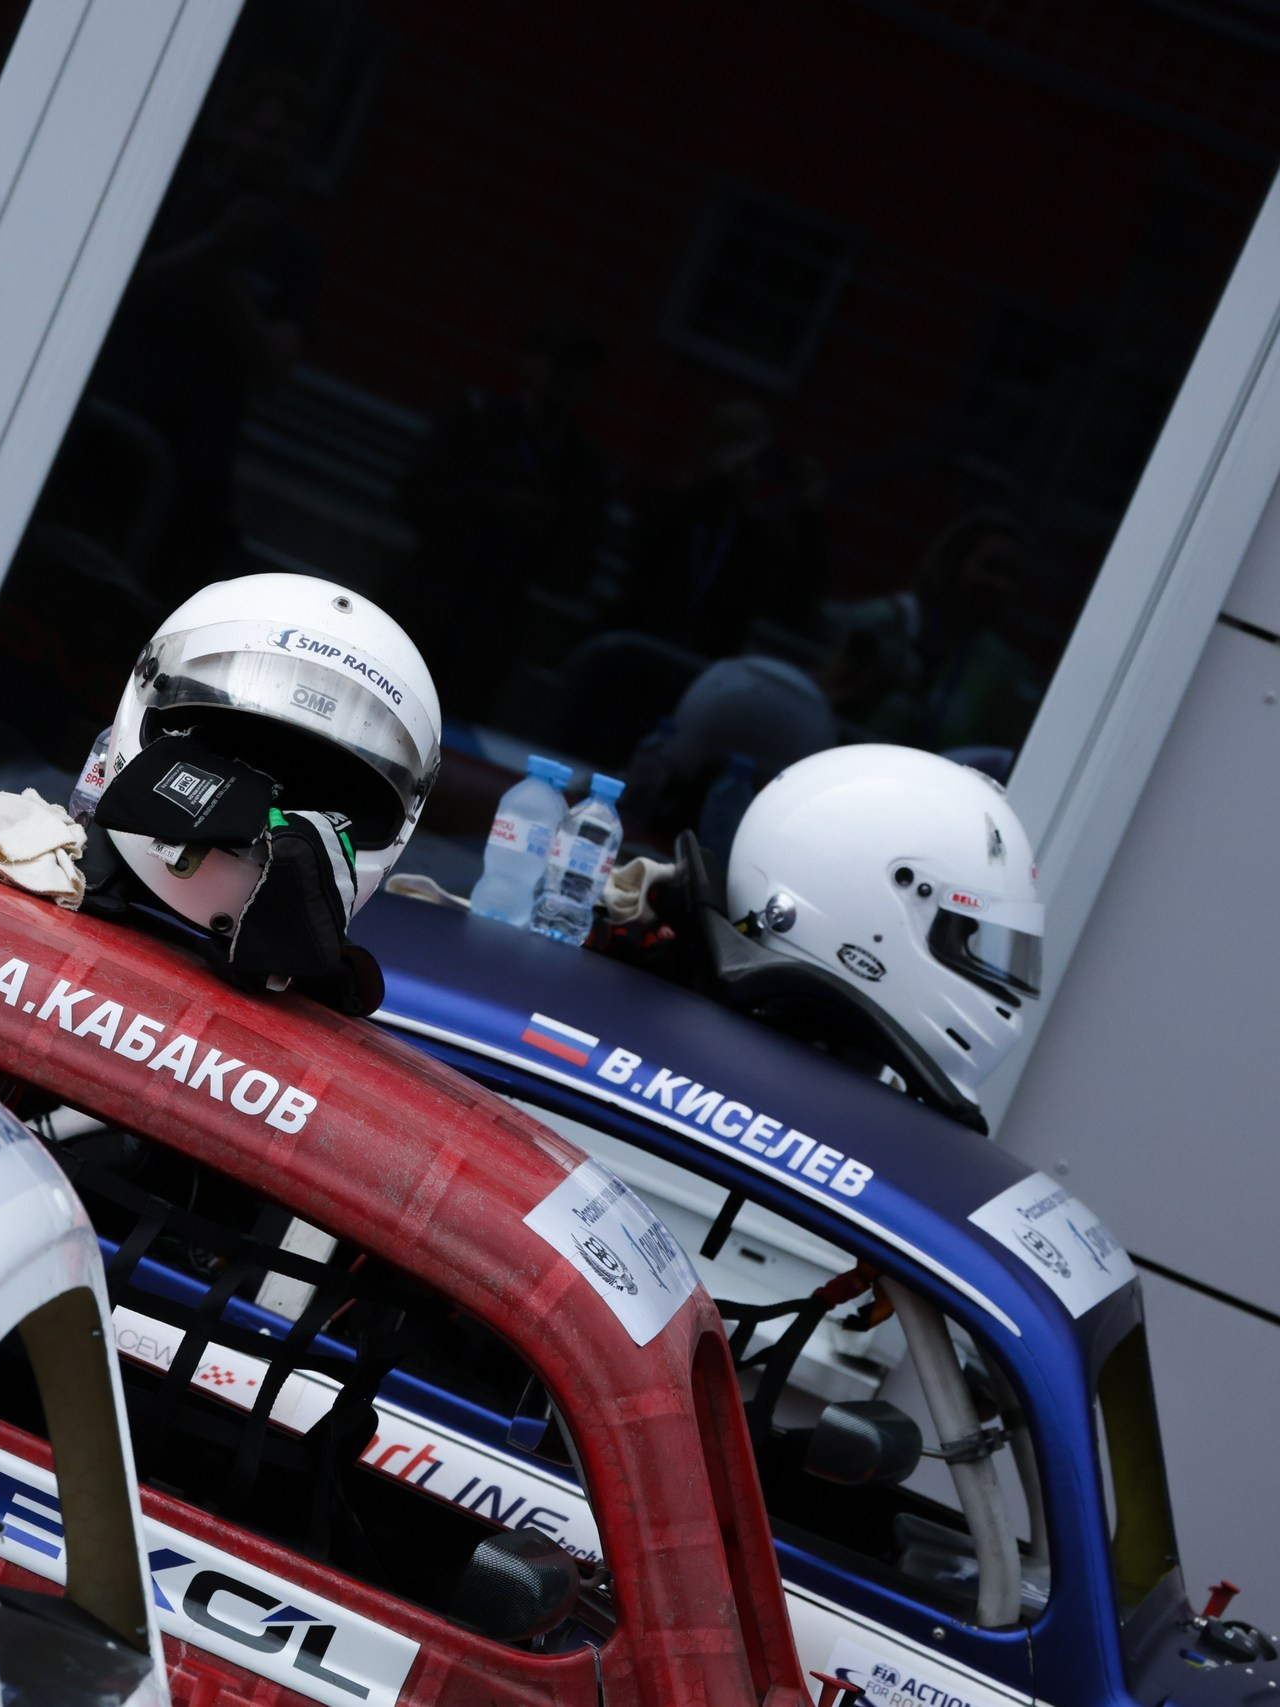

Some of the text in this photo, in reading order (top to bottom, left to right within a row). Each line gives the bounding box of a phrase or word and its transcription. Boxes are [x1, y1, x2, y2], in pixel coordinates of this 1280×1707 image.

[296, 637, 403, 705] SMP RACING
[293, 688, 337, 715] OMP
[178, 775, 193, 792] OMP
[952, 893, 980, 908] BELL
[596, 1047, 874, 1198] В.КИСЕЛЕВ
[865, 1680, 891, 1698] FOR
